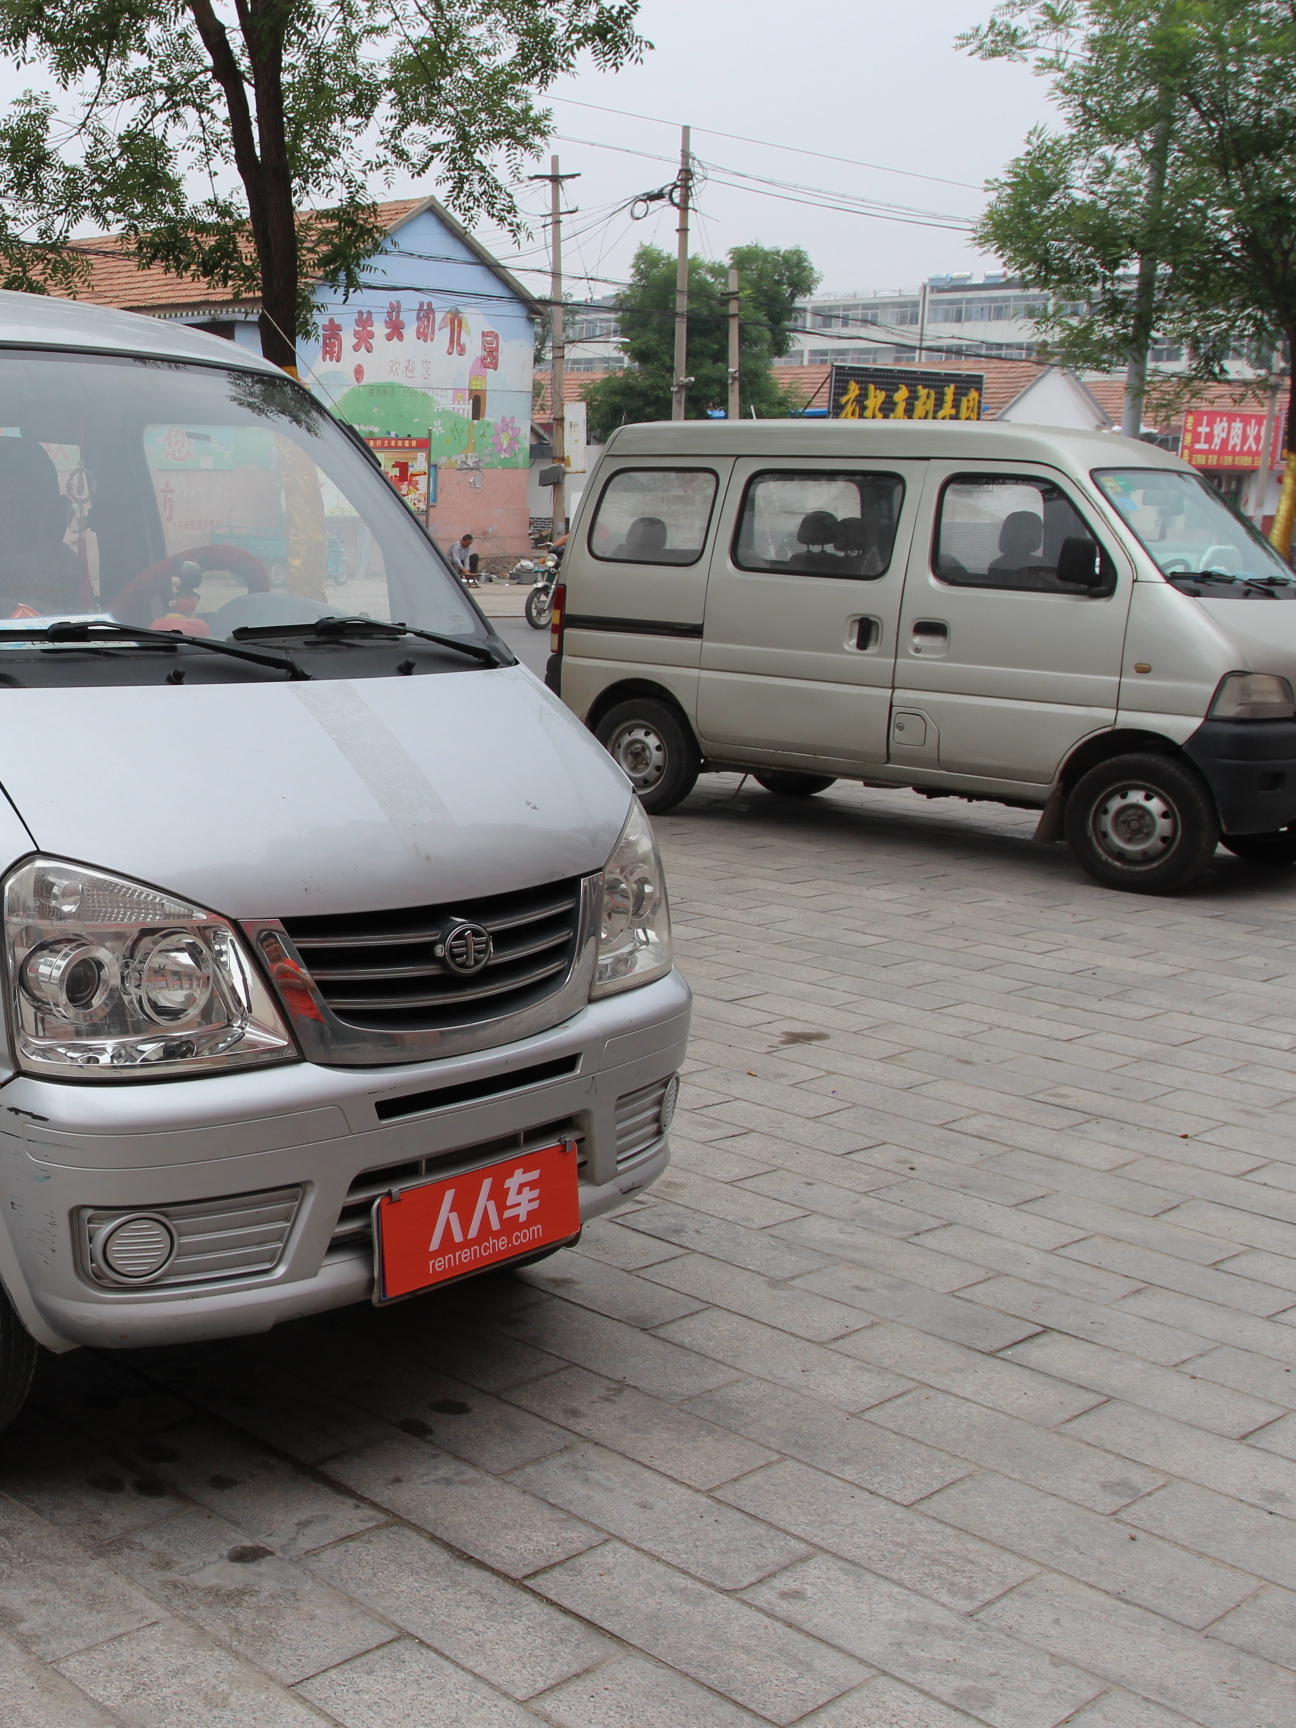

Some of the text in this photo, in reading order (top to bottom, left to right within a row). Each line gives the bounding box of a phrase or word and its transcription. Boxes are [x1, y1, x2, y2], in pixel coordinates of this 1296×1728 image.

[322, 300, 500, 371] 南关头幼儿园
[389, 358, 431, 379] 欢迎您
[428, 1168, 541, 1251] 人人车
[429, 1224, 542, 1274] renrenche.com
